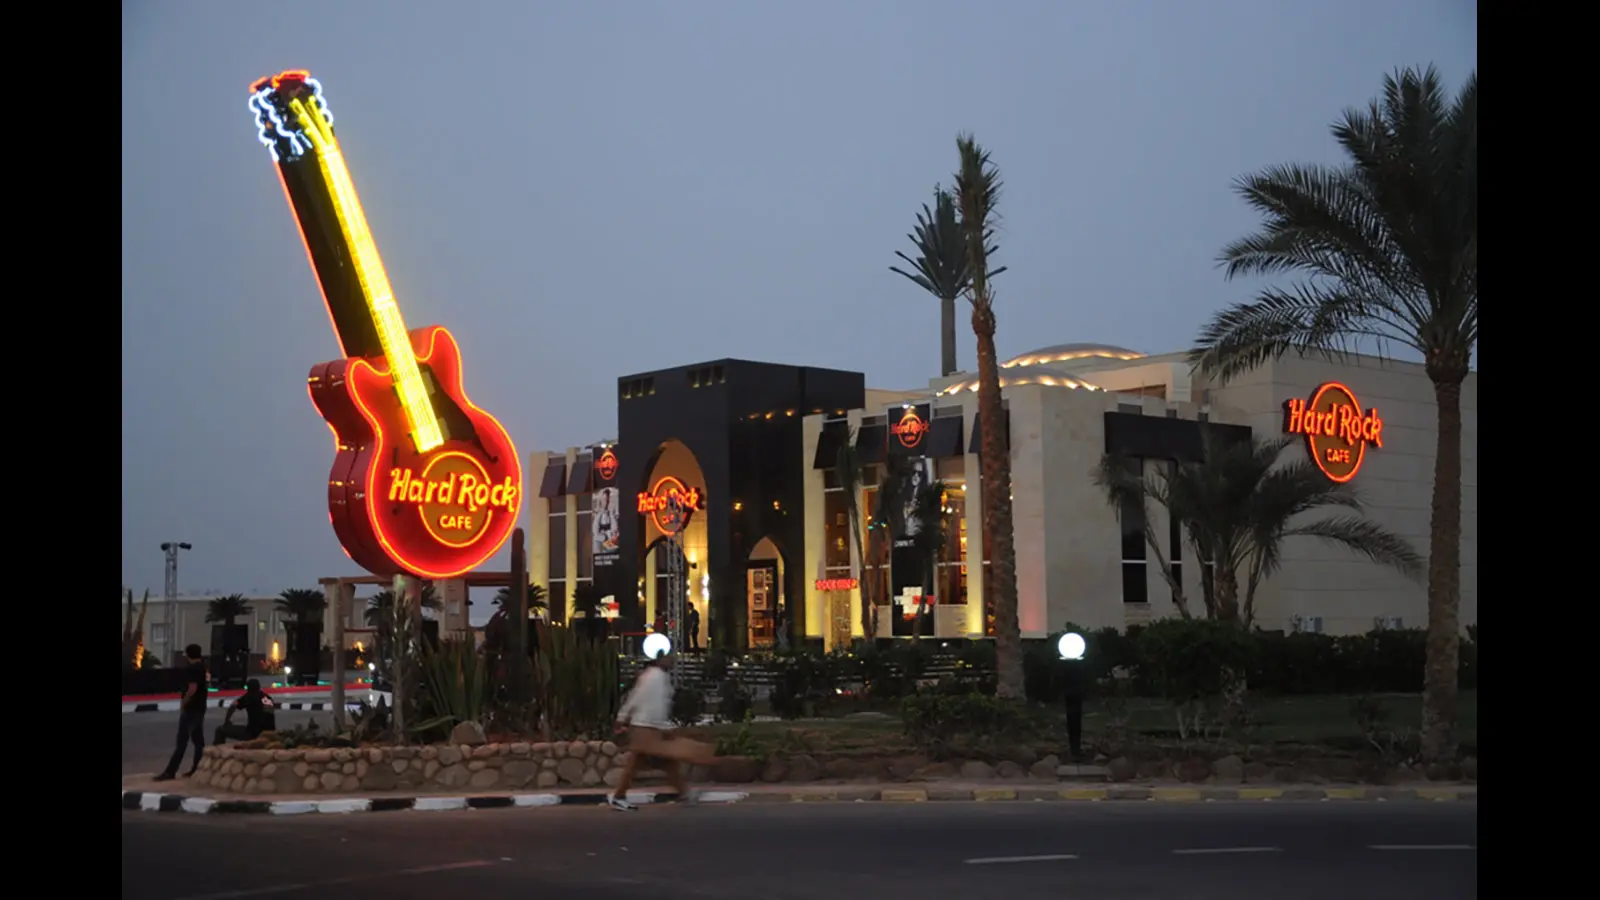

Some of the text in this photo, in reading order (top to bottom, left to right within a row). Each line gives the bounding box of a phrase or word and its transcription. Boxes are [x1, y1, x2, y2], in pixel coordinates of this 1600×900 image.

[1288, 398, 1383, 448] Hard Rock
[1326, 448, 1350, 463] CAFE
[388, 467, 517, 513] Hard Rock
[637, 489, 669, 513] Hard
[439, 515, 473, 529] CAFE
